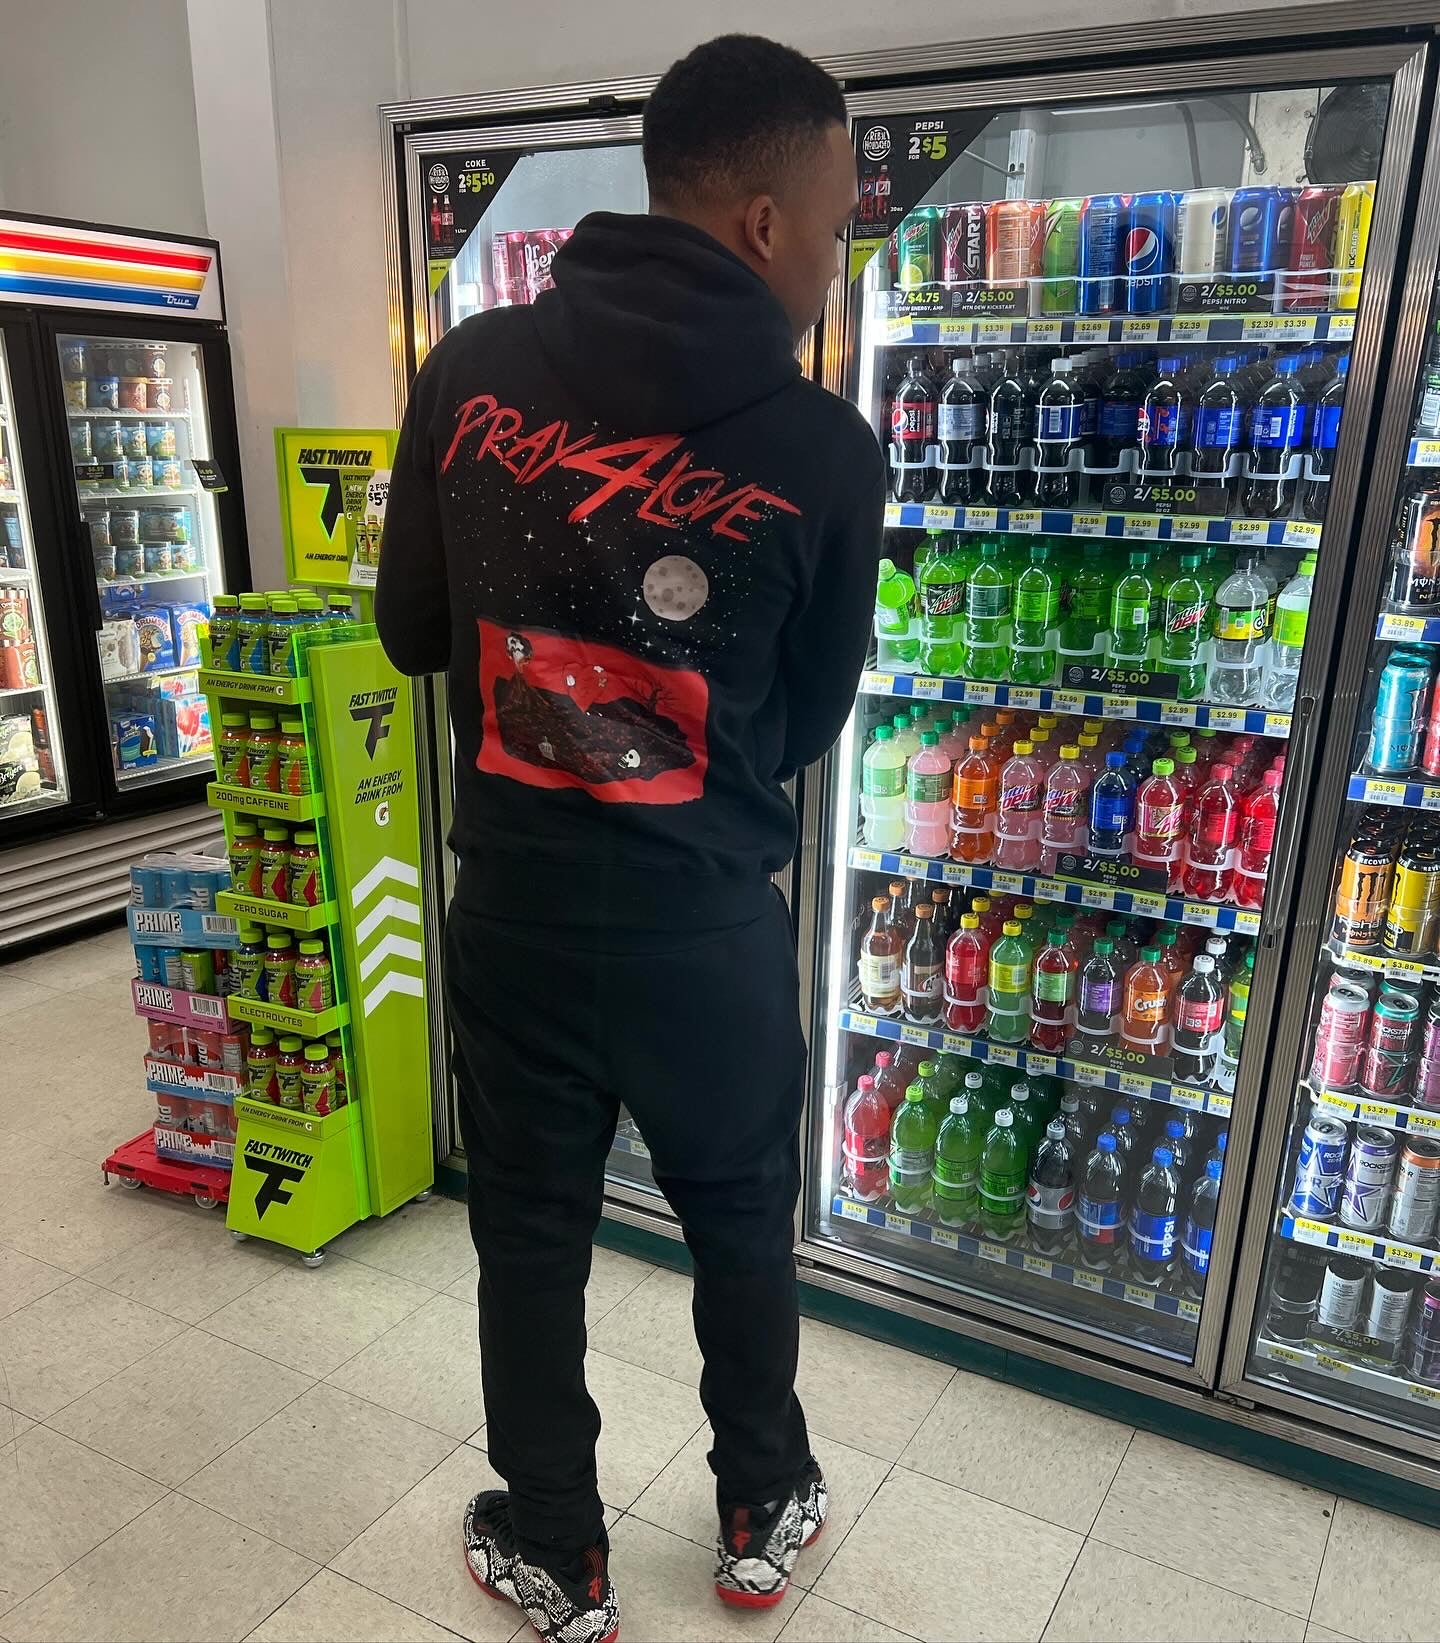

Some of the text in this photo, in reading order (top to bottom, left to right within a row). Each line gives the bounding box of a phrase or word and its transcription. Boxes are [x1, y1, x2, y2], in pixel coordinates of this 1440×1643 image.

[915, 121, 944, 131] PEPSI
[465, 160, 486, 168] COKE
[1200, 284, 1258, 298] 2/$5.00
[162, 294, 192, 306] true
[895, 292, 940, 304] 2/$4.75
[966, 291, 1014, 303] 2/$5.00
[1034, 324, 1054, 332] $2.69
[1081, 323, 1102, 332] $2.69
[1130, 322, 1150, 330] $2.69
[297, 448, 372, 466] FAST TWITCH
[369, 484, 374, 492] 2
[1134, 486, 1196, 502] 2/$5.00
[1016, 512, 1034, 520] $2.99
[1238, 522, 1260, 532] $2.99
[1294, 525, 1316, 534] $2.99
[1392, 618, 1414, 628] $3.89
[1091, 668, 1150, 684] 2/$5.00
[214, 680, 238, 689] ENERGY
[238, 683, 256, 692] DRINK
[257, 685, 275, 693] FROM
[275, 685, 284, 696] G
[349, 687, 398, 708] FAST TWITCH
[1015, 690, 1033, 698] $2.99
[1058, 695, 1077, 703] $2.99
[1217, 711, 1237, 719] $2.99
[357, 769, 402, 790] AN ENERGY
[355, 782, 403, 804] DRINK FROM
[1374, 784, 1396, 792] $3.89
[216, 792, 289, 810] 200mg CAFFEINE
[374, 800, 390, 827] G
[949, 867, 966, 875] $2.99
[1083, 859, 1140, 878] 2/$5.00
[1040, 882, 1059, 890] $2.99
[1140, 898, 1158, 906] $2.99
[234, 903, 289, 921] ZERO SUGAR
[1190, 907, 1210, 915] $2.99
[134, 911, 183, 937] PRIME
[1352, 954, 1373, 965] $3.89
[1392, 961, 1414, 970] $3.89
[137, 989, 173, 1012] PRIME
[240, 1006, 303, 1027] ELECTROLYTES
[1032, 1056, 1049, 1064] $2.99
[1090, 1045, 1145, 1064] 2/$5.00
[148, 1061, 184, 1086] PRIME
[1178, 1090, 1197, 1098] $2.99
[1328, 1097, 1347, 1108] $3.29
[1367, 1105, 1388, 1114] $3.29
[241, 1106, 250, 1114] AN
[250, 1108, 271, 1119] ENERGY
[271, 1113, 288, 1124] DRINK
[288, 1118, 304, 1128] FROM
[1415, 1118, 1436, 1127] $3.29
[244, 1139, 312, 1170] FAST TWITCH
[1301, 1222, 1321, 1231] $3.29
[1162, 1220, 1174, 1256] PEPSI
[1345, 1235, 1366, 1244] $3.29
[1391, 1248, 1413, 1259] $3.29
[1330, 1328, 1380, 1346] 2/$5.00
[1336, 1336, 1362, 1347] CELSIUS
